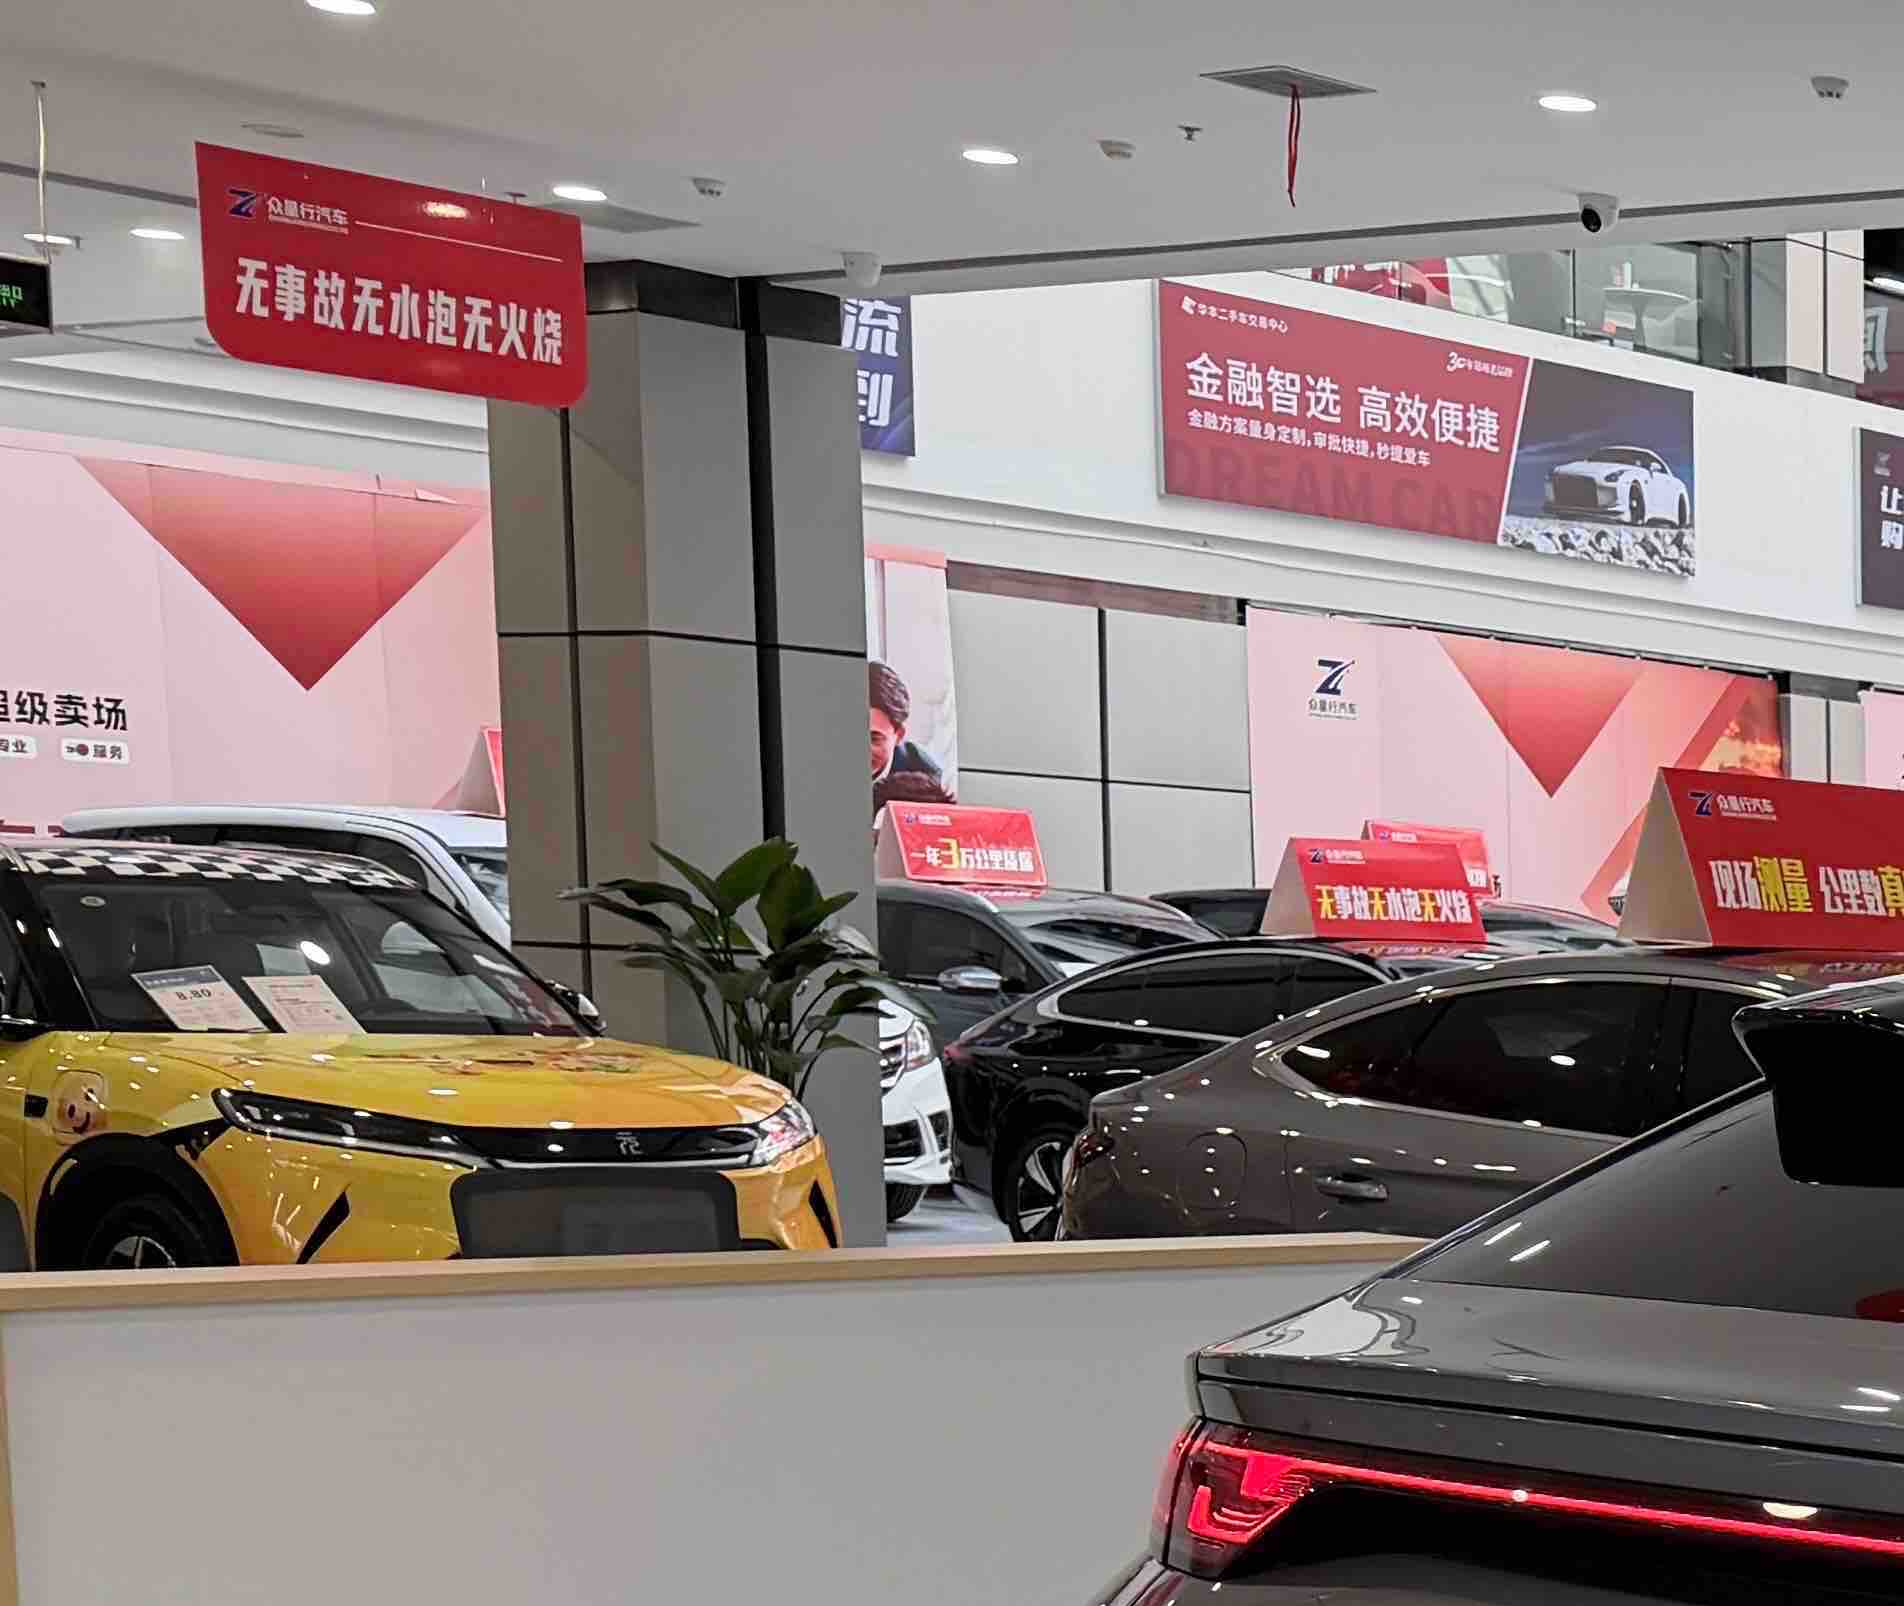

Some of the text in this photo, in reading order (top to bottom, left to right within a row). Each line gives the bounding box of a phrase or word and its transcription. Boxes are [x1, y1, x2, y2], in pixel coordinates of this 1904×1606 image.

[267, 195, 349, 226] 众星行汽车
[235, 256, 564, 366] 无事故无水泡无火烧
[1185, 351, 1501, 453] 金融智选 高效便捷
[1315, 884, 1473, 924] 无事故无水泡无火烧
[1708, 855, 1814, 913] 现场测量
